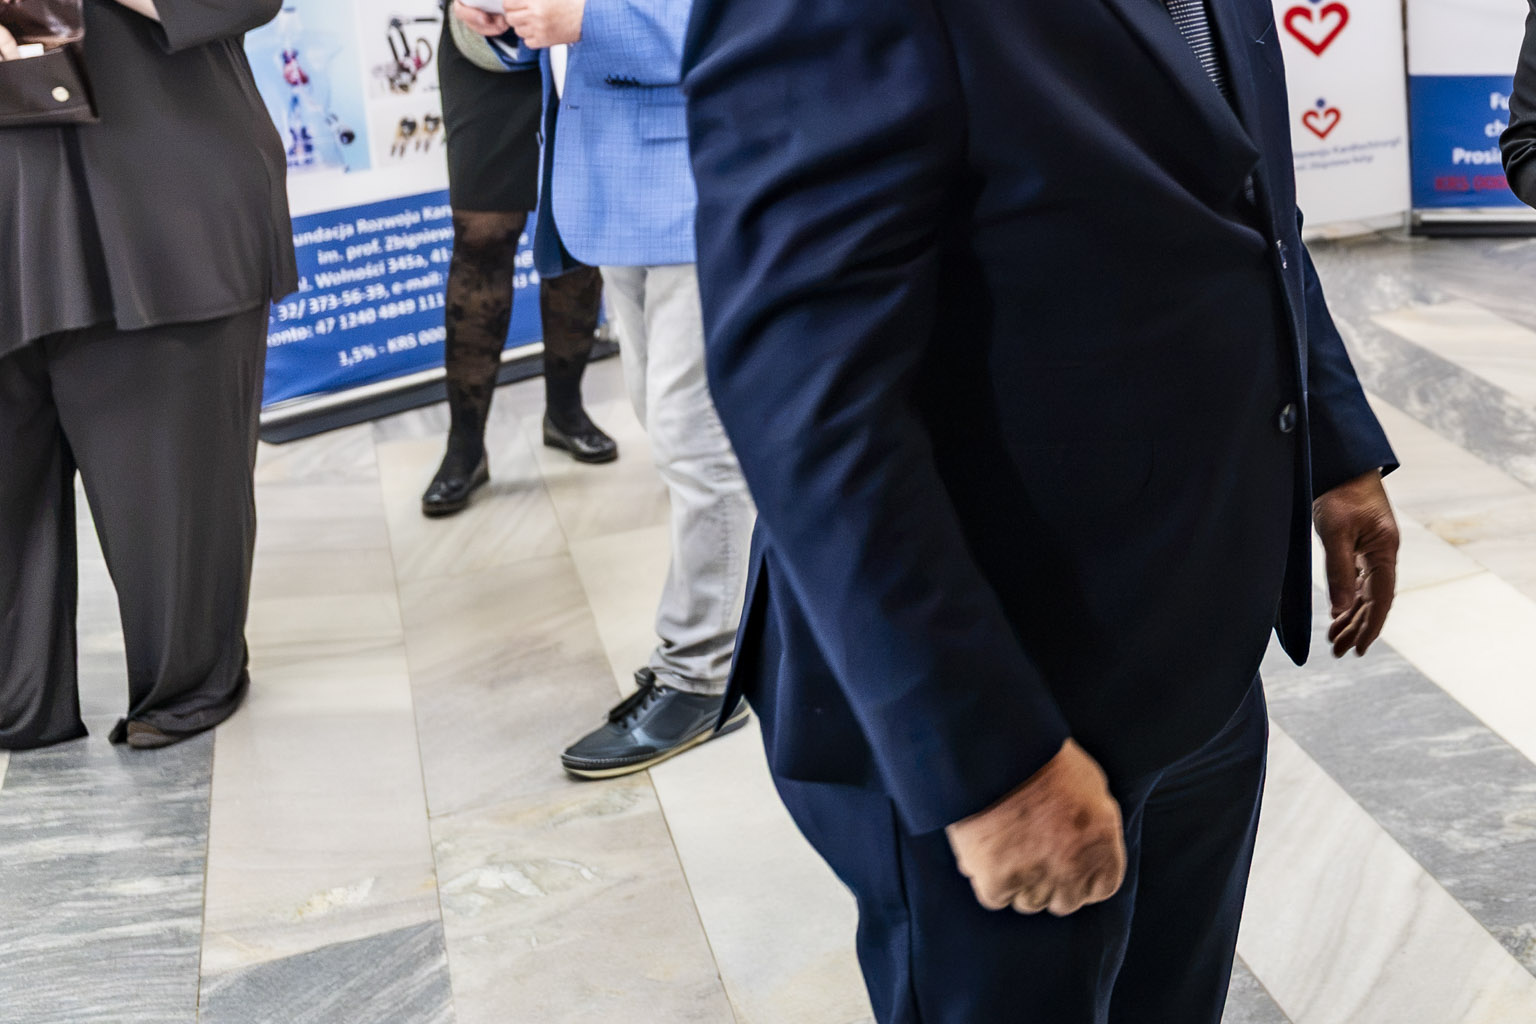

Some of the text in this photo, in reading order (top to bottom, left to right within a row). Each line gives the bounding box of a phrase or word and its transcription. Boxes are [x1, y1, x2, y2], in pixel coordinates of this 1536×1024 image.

[293, 222, 354, 248] undacja
[356, 209, 421, 234] Rozwoju
[317, 226, 455, 265] im. prof. Zbigniew
[314, 260, 385, 289] Wolności
